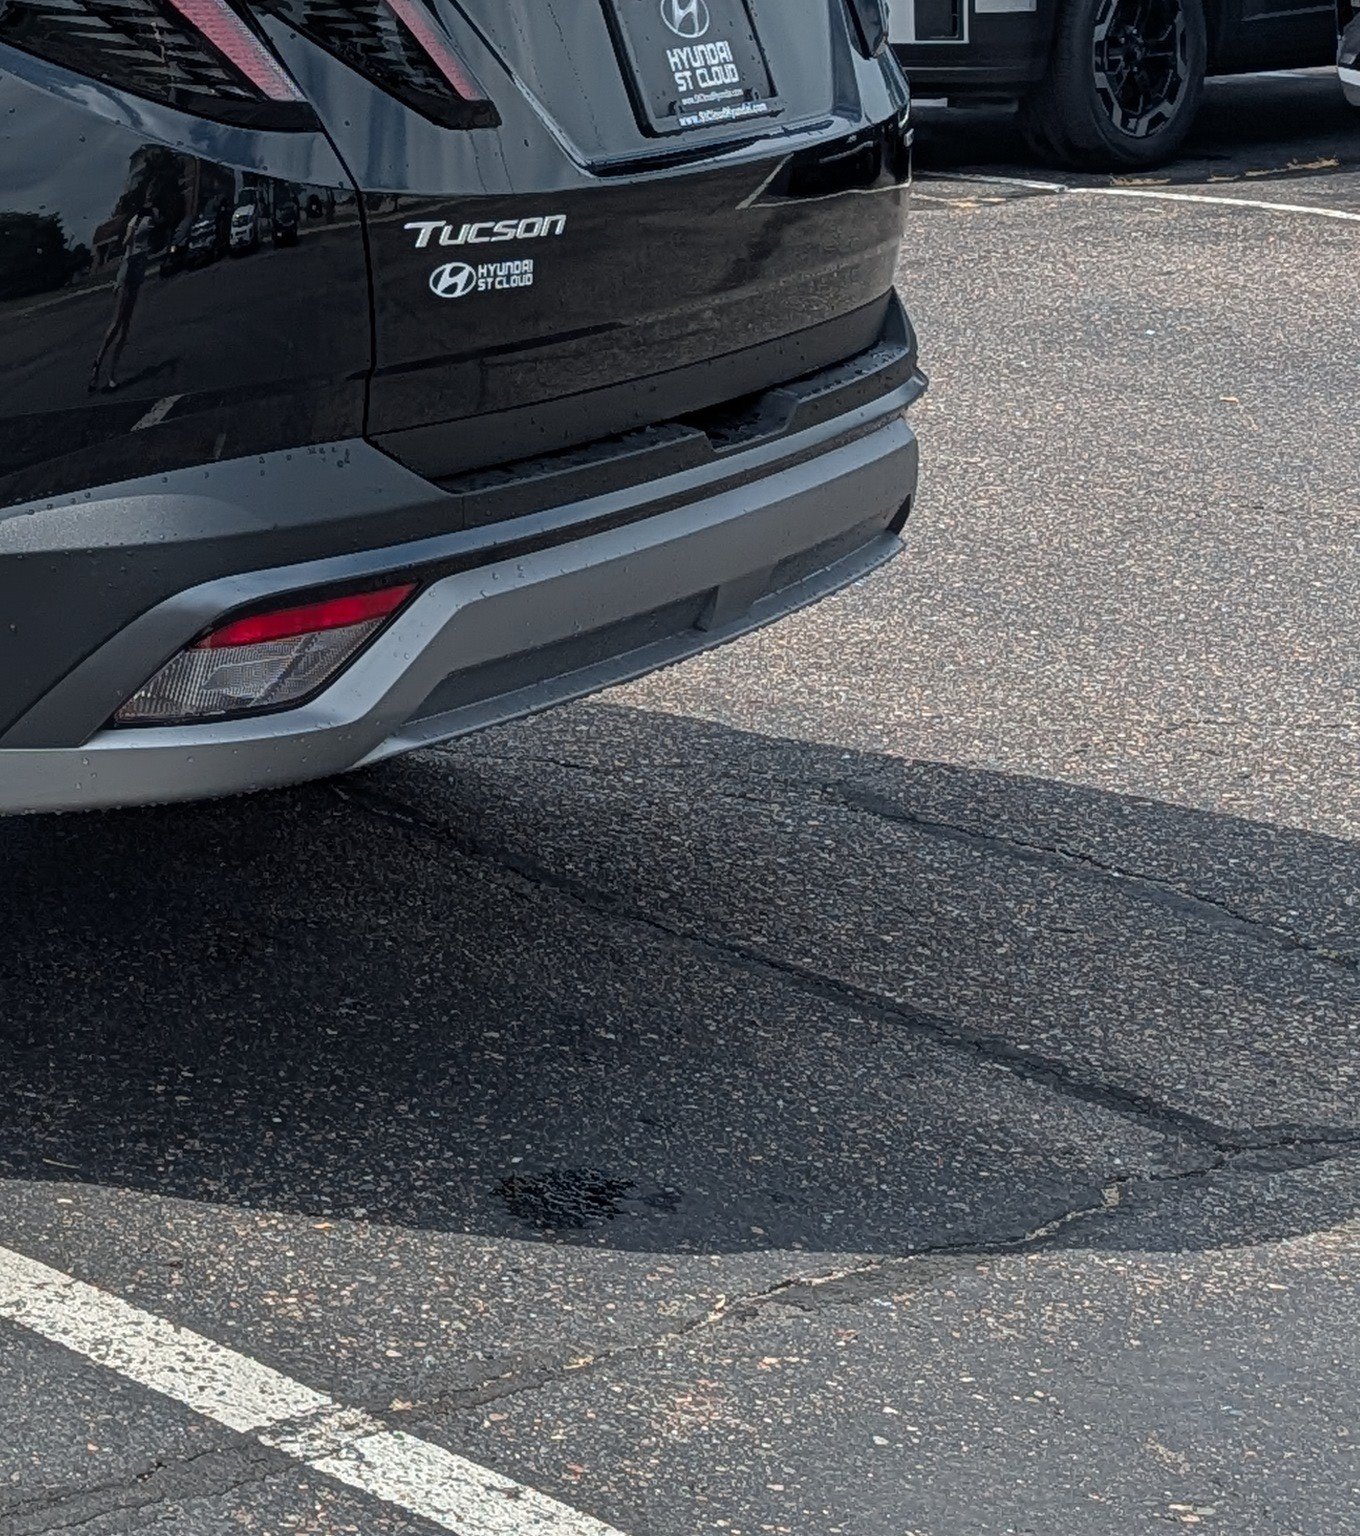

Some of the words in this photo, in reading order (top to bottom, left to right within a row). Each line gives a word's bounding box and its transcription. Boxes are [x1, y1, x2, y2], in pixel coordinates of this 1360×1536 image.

[666, 40, 734, 72] HYUNDAI
[674, 72, 695, 92] ST
[696, 64, 740, 89] CLOUD
[477, 259, 534, 278] HYUNDAI
[477, 278, 492, 291] ST
[494, 274, 533, 290] CLOUD
